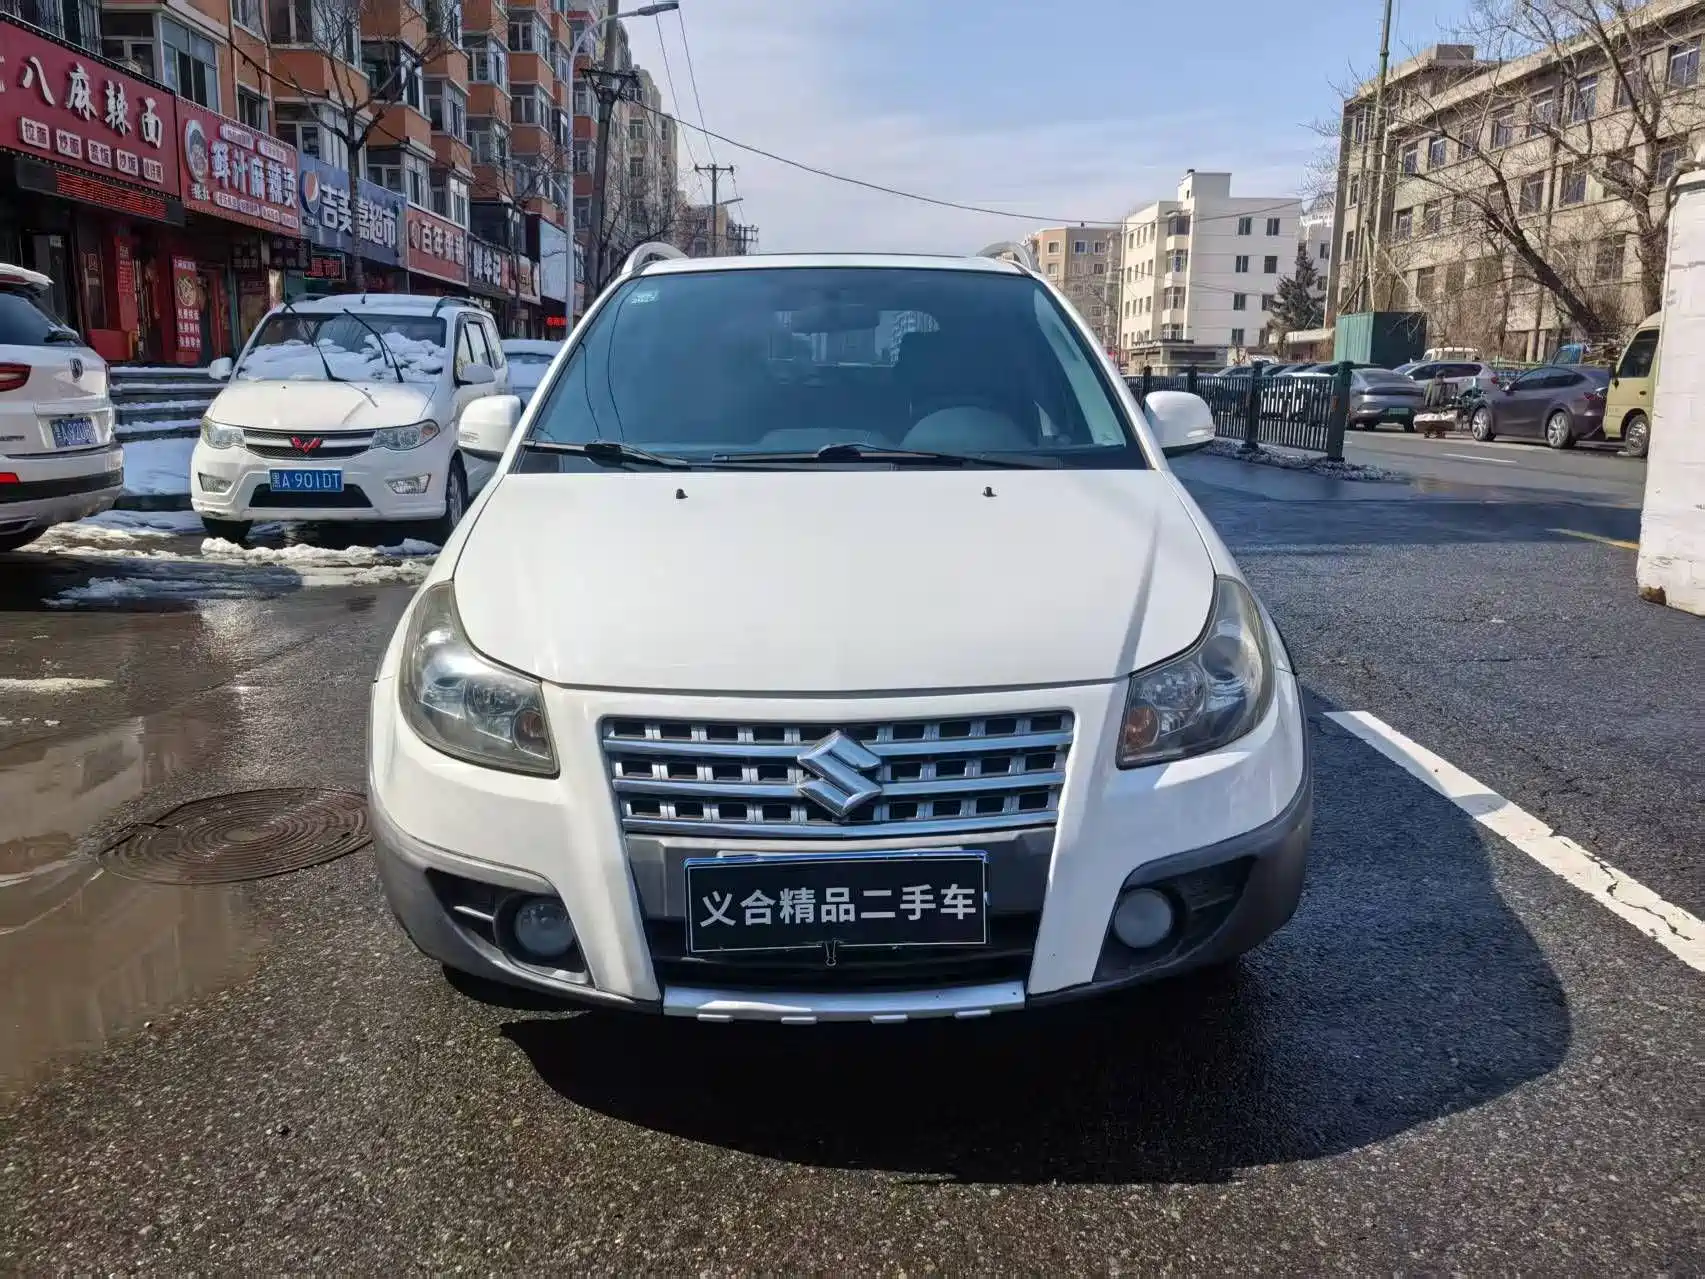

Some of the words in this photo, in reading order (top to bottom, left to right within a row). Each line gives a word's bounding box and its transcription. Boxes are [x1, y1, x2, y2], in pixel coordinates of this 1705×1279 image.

[0, 55, 163, 149] 八麻辣面
[699, 883, 977, 928] 义合精品二手车
